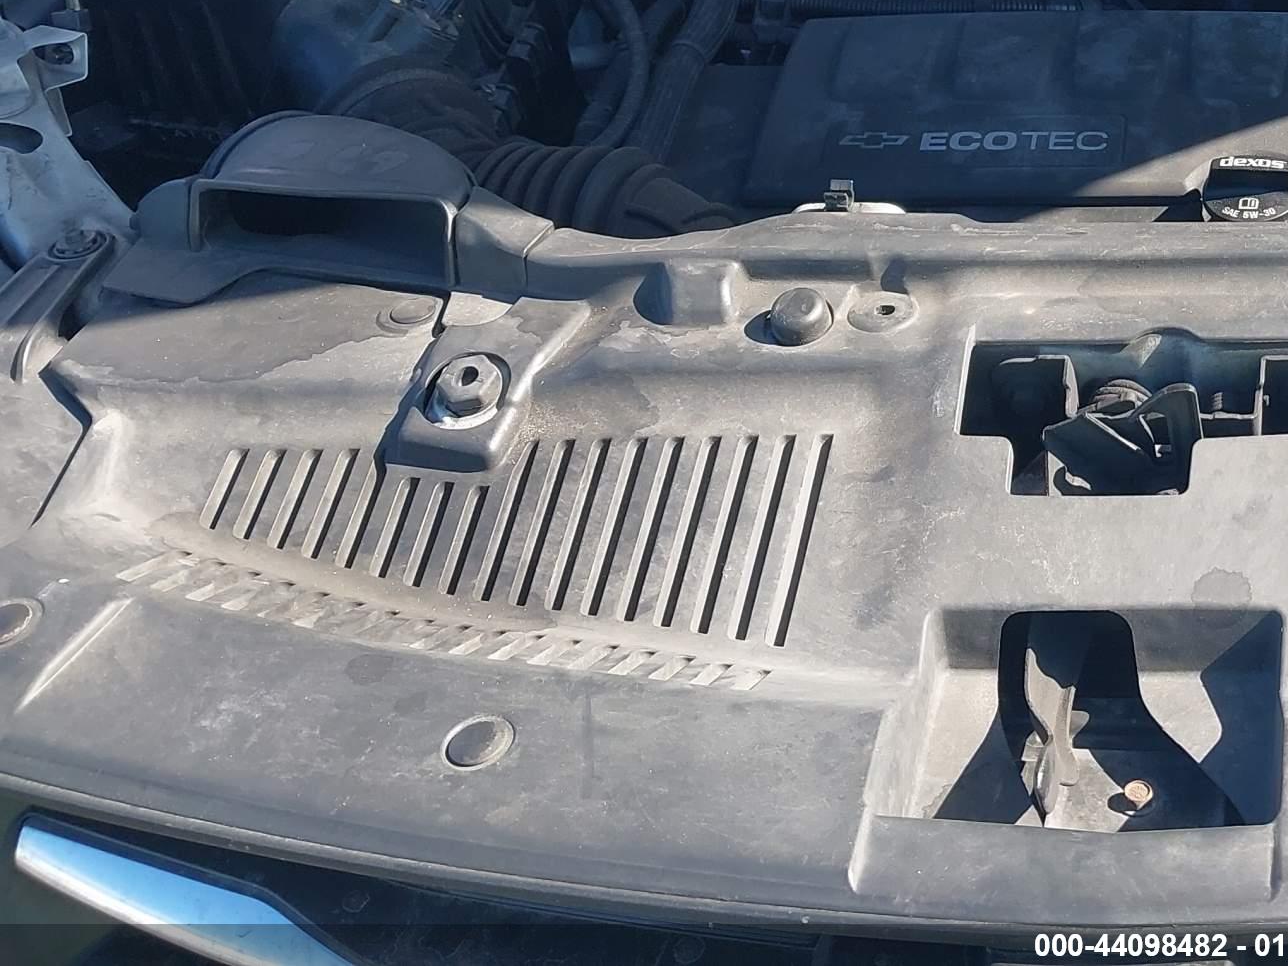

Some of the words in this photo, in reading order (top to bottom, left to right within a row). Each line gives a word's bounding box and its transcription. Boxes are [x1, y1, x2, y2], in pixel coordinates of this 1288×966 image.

[919, 131, 1109, 151] ECOTEC
[1220, 156, 1286, 169] dexos
[1221, 206, 1241, 218] SAE
[1242, 207, 1277, 220] 5W-30
